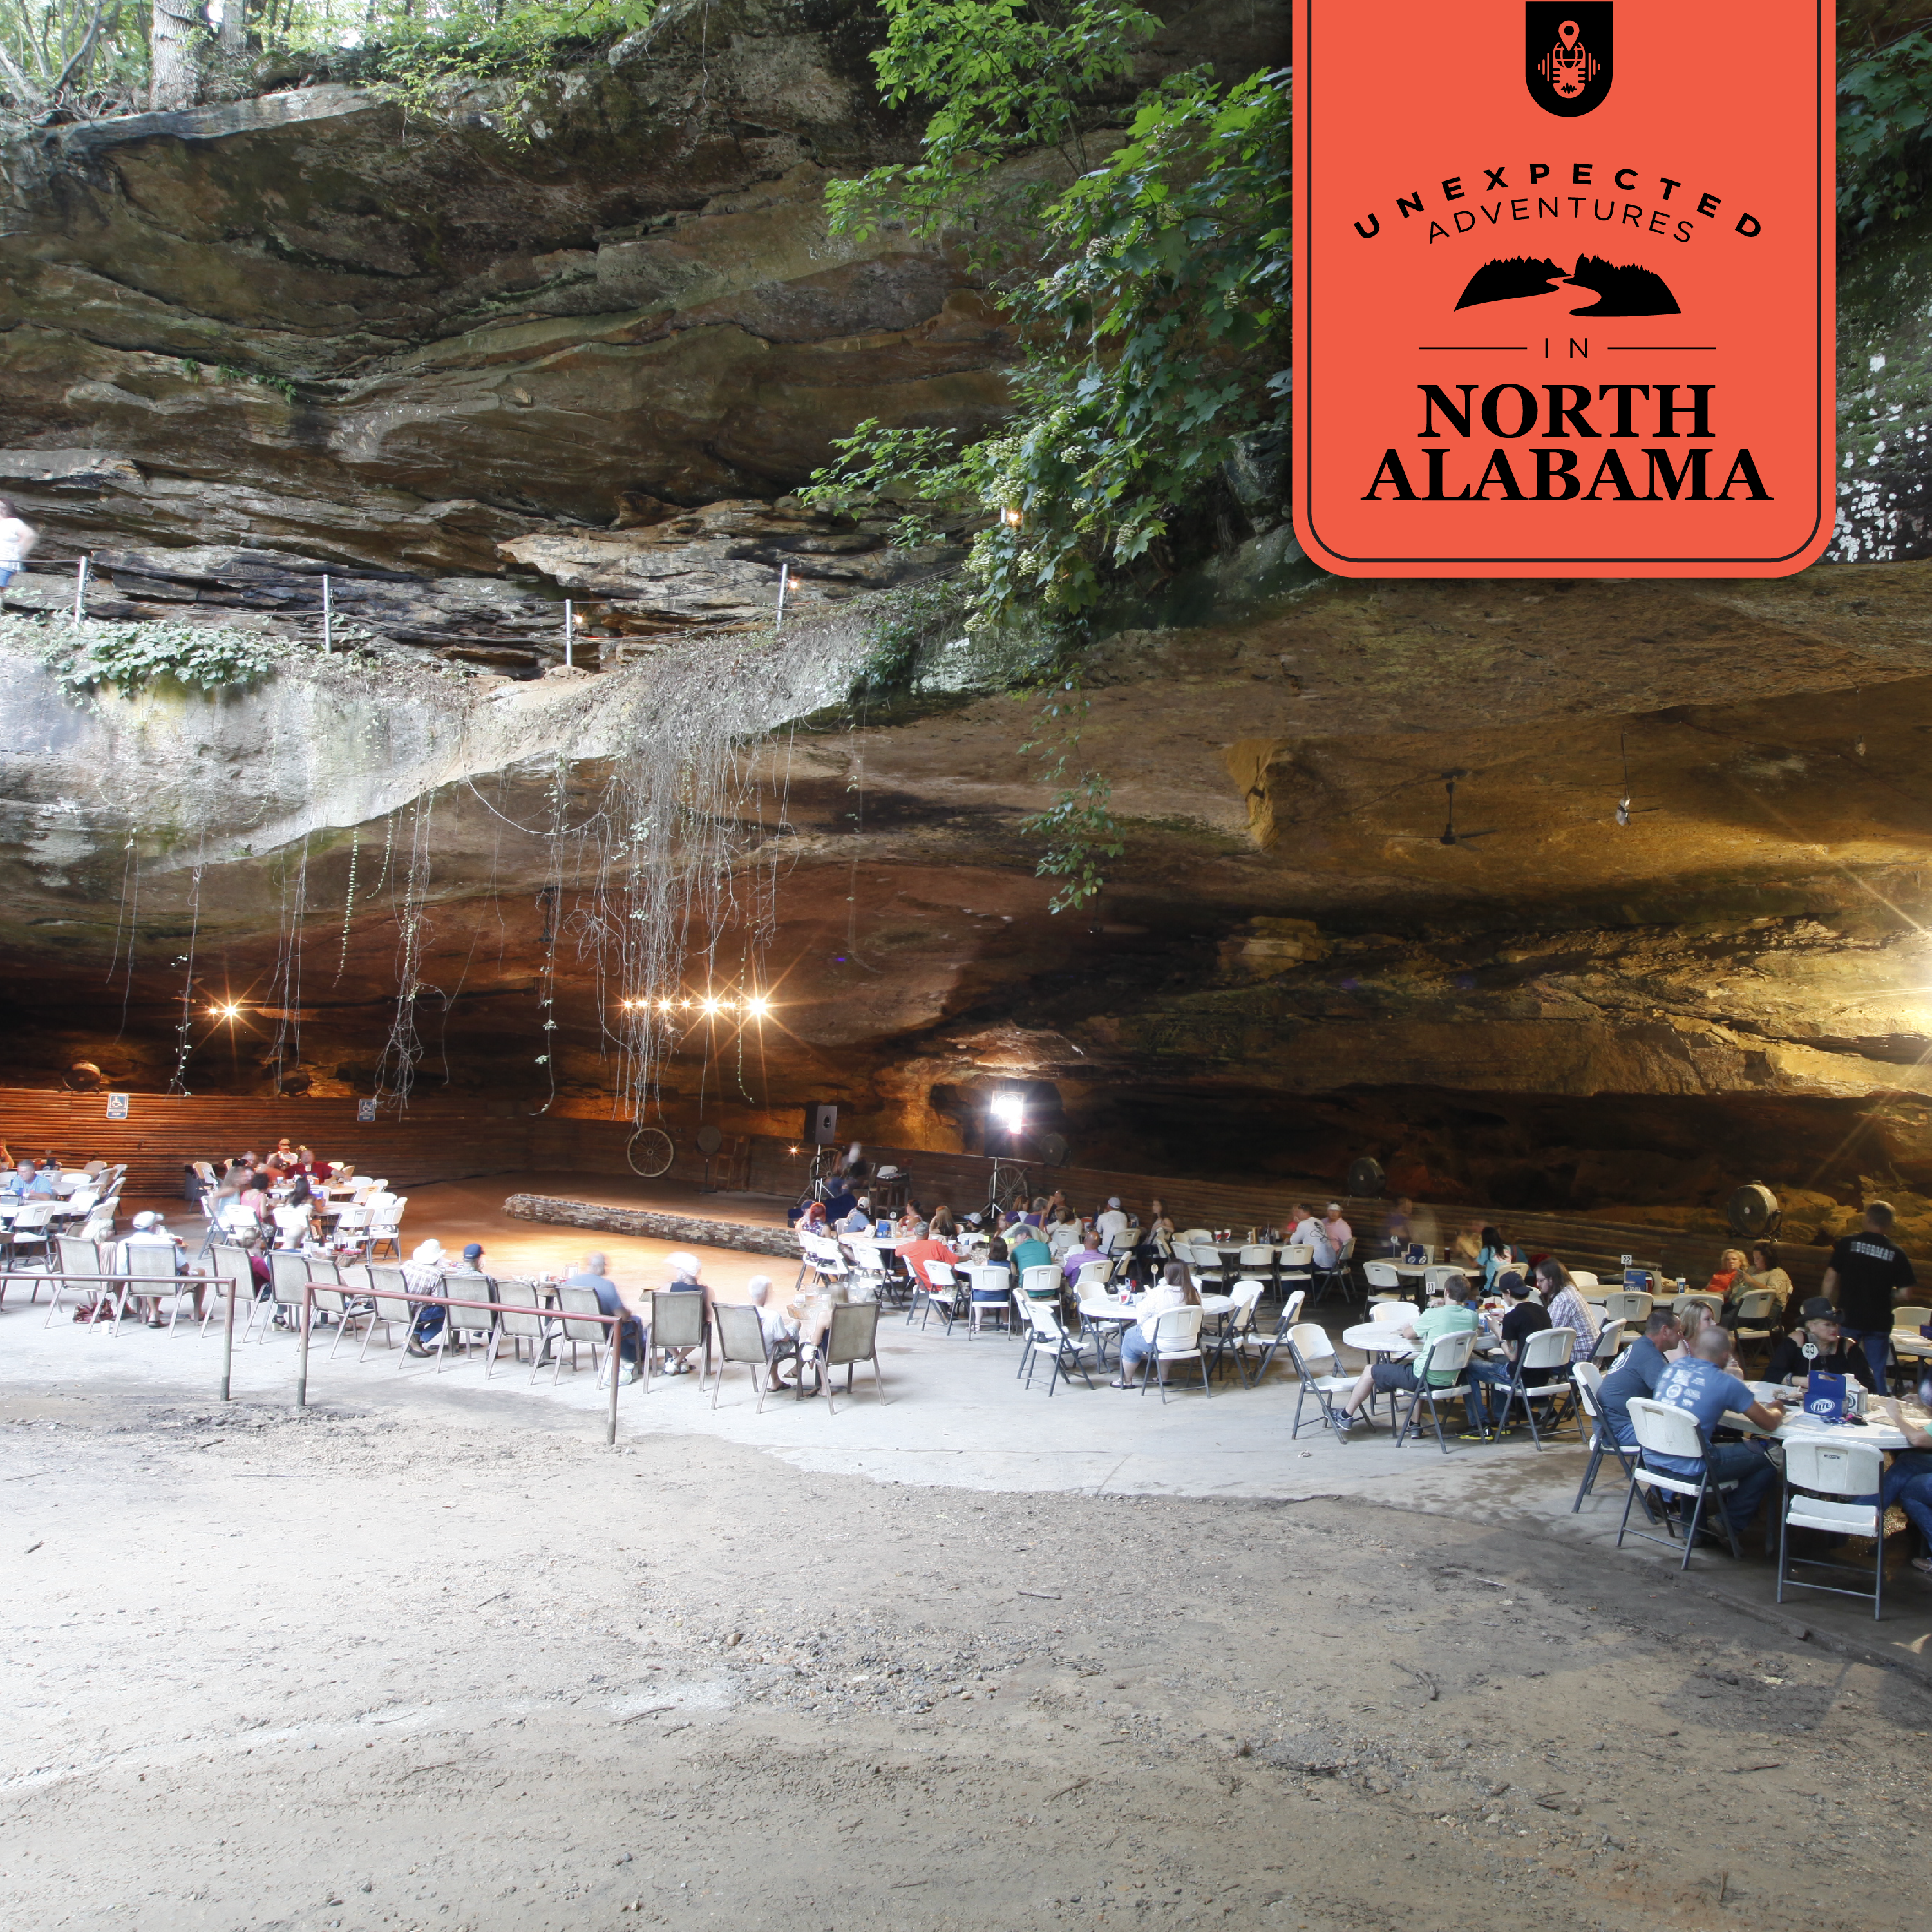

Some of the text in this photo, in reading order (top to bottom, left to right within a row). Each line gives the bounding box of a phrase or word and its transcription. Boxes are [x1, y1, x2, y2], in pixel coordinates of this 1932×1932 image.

[1427, 1283, 1434, 1293] 21
[1805, 1344, 1815, 1354] 23
[1815, 1402, 1832, 1412] Lite
